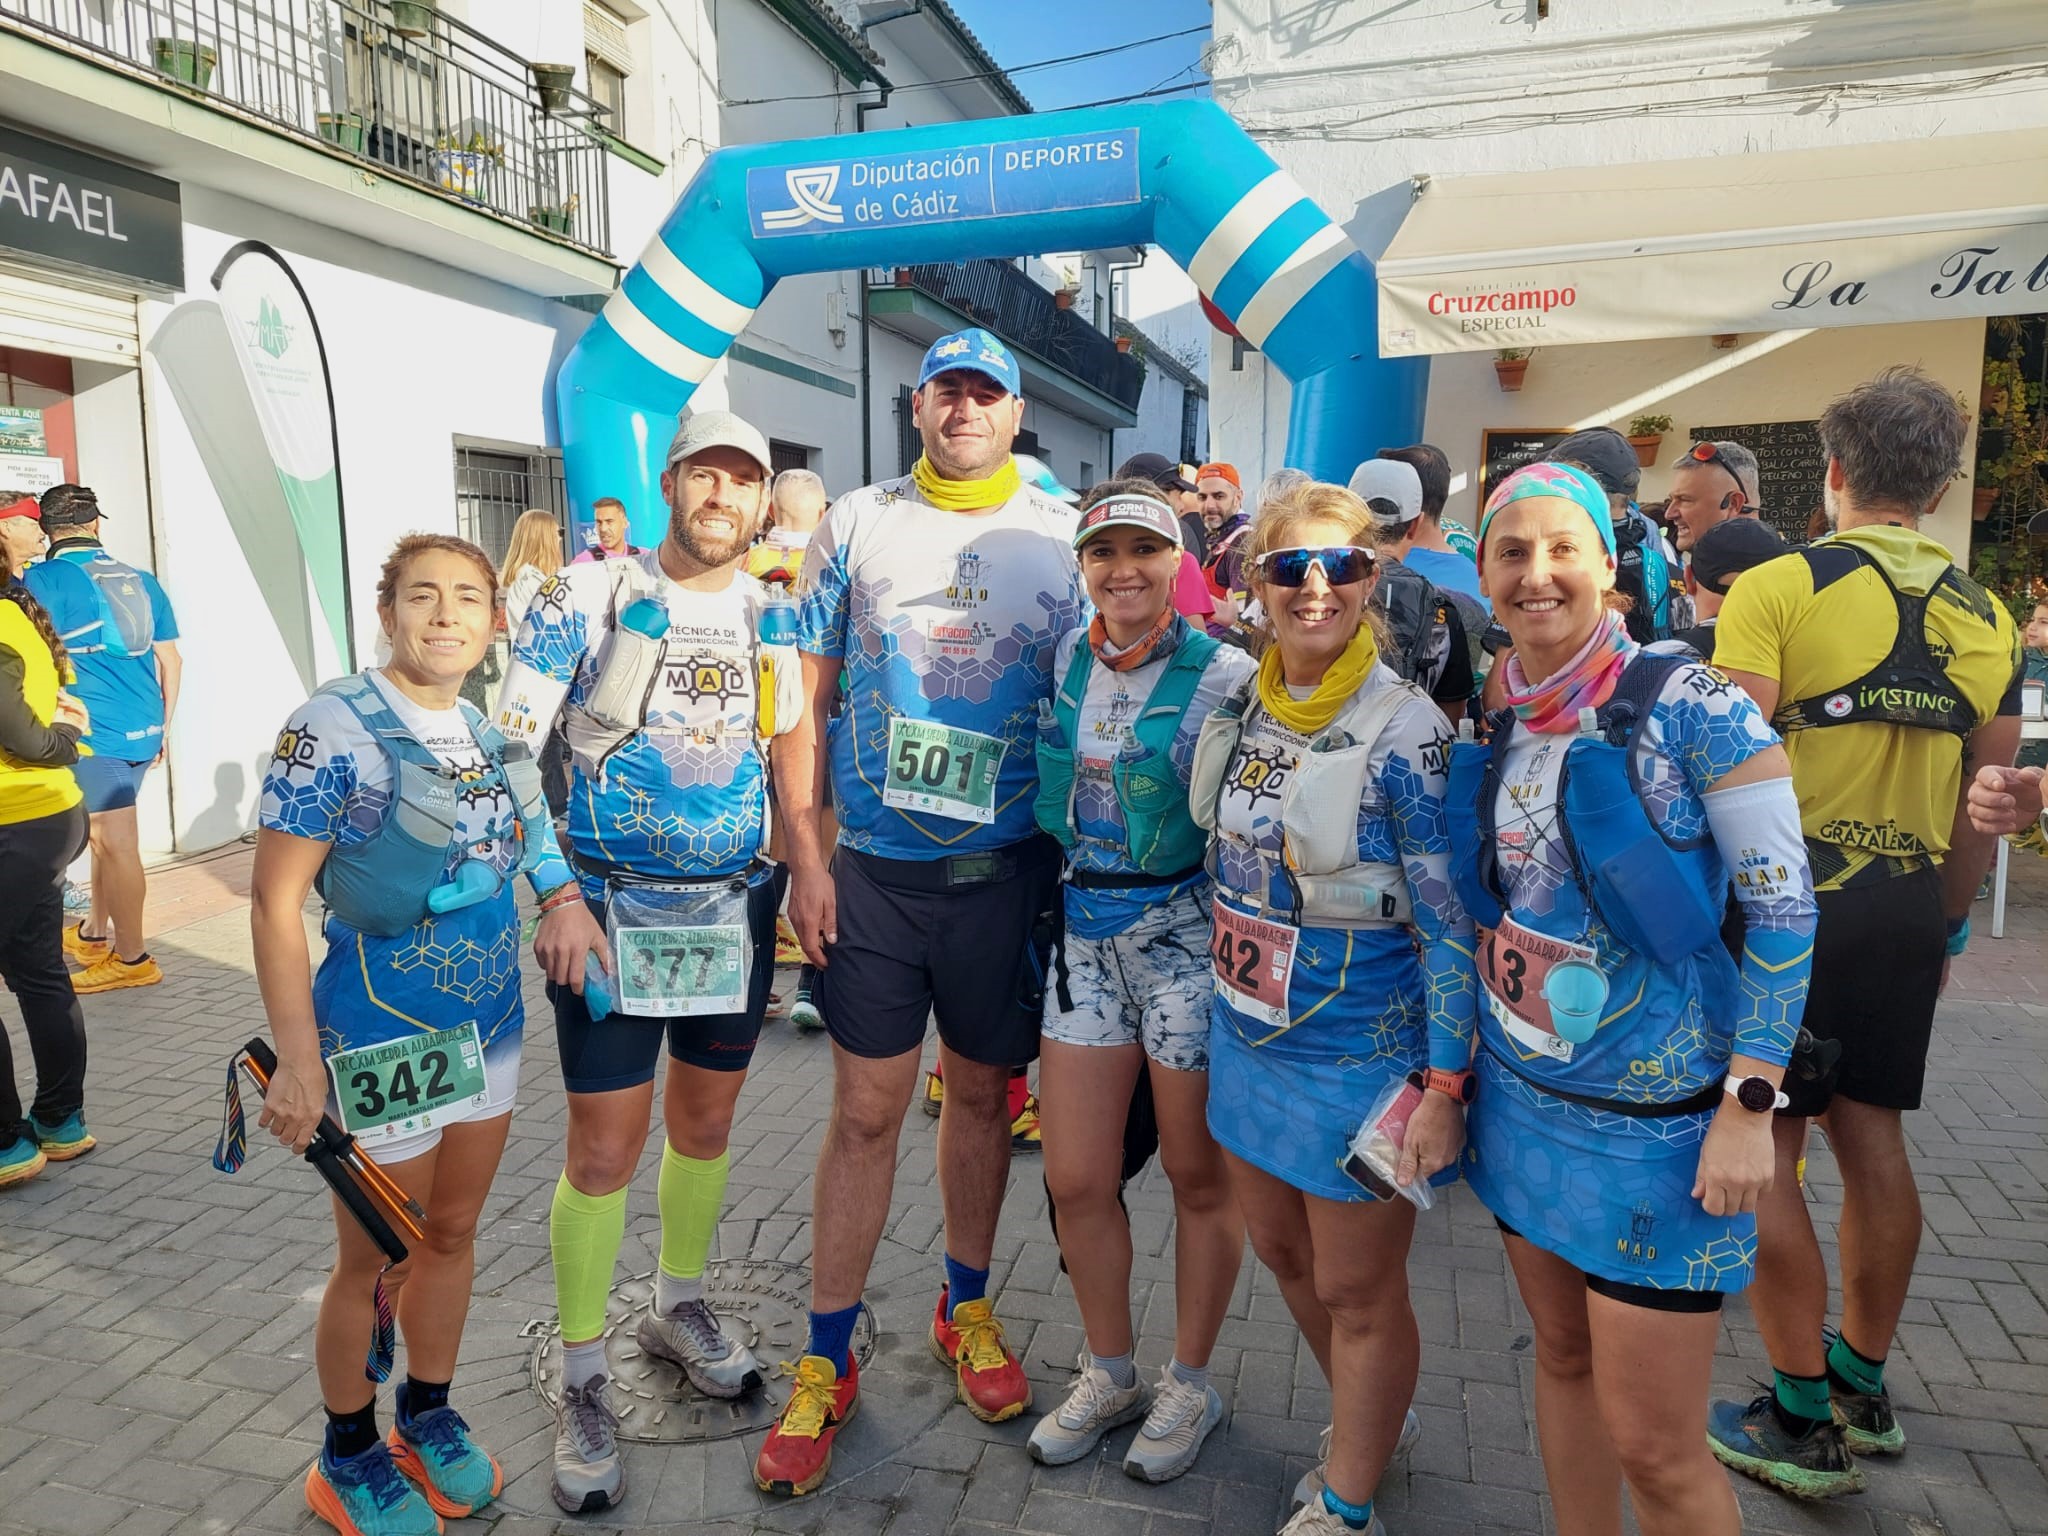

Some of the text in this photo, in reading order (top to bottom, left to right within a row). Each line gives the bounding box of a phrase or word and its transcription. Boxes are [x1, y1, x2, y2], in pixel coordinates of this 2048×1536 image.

[1005, 140, 1124, 171] DEPORTES
[851, 153, 980, 189] Diputación
[855, 191, 959, 222] de Cádiz
[1772, 261, 1869, 310] La
[1428, 287, 1576, 315] Cruzcampo
[1461, 315, 1546, 333] ESPECIAL
[1109, 503, 1144, 513] BORN
[669, 624, 737, 639] TÉCNICA DE
[666, 670, 744, 690] MAD
[896, 740, 974, 793] 501
[1820, 820, 1929, 852] GRAZALEMA
[1739, 856, 1770, 869] TEAM
[1736, 865, 1788, 887] MAD
[1750, 886, 1782, 896] RONDA
[631, 947, 715, 990] 377
[1630, 1059, 1662, 1076] OS
[351, 1051, 456, 1118] 342
[1617, 1238, 1657, 1260] MAD
